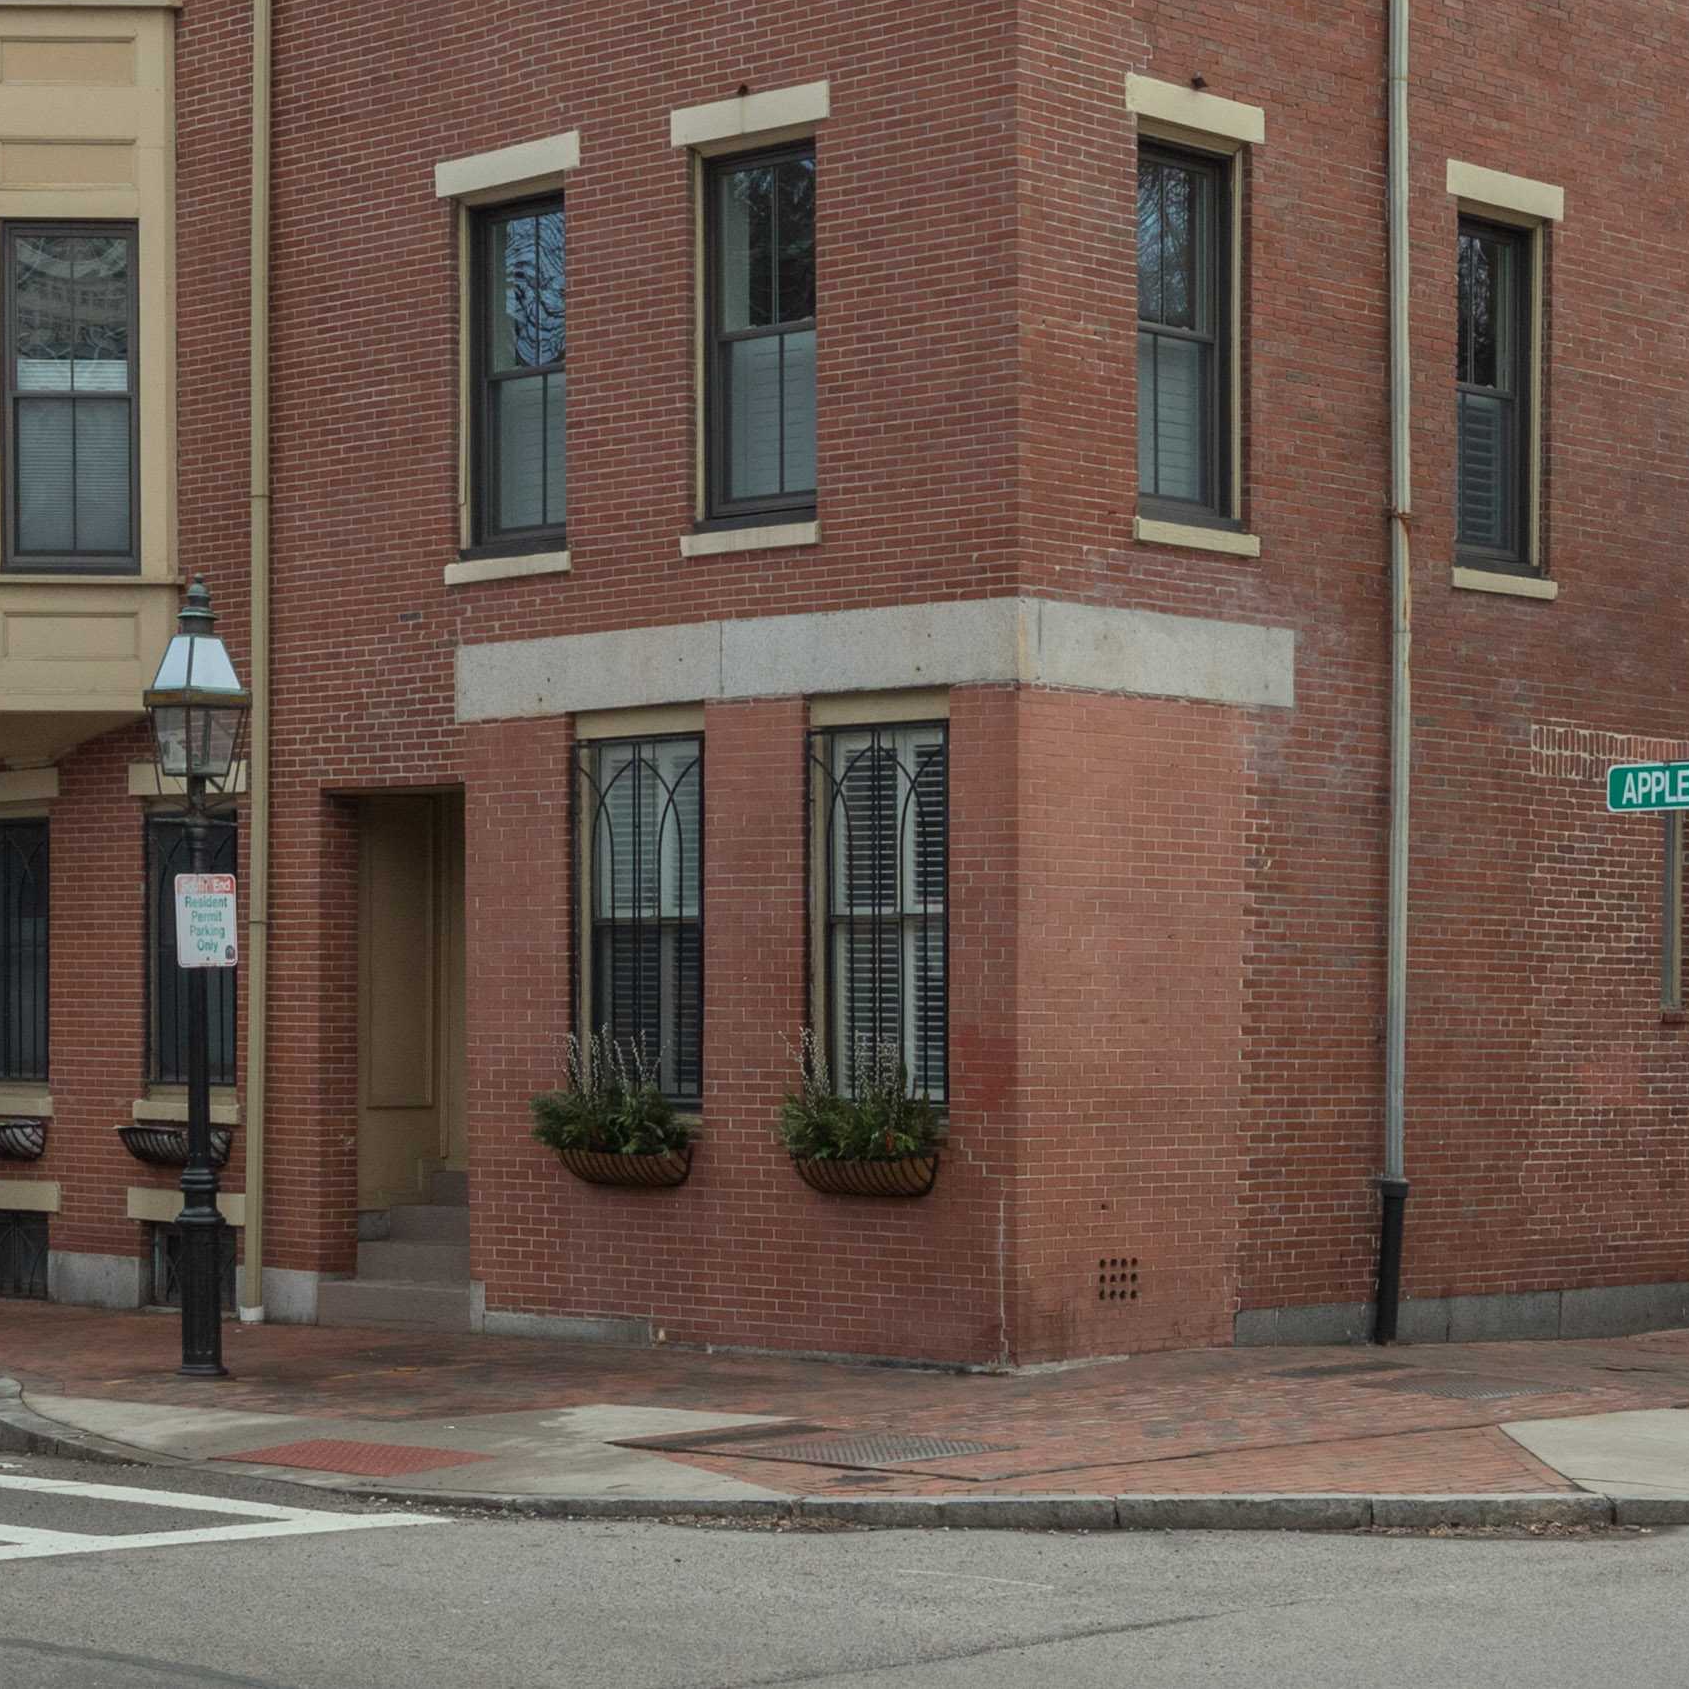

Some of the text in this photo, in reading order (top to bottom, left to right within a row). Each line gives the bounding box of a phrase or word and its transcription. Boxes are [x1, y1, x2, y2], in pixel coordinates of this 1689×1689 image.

[213, 878, 231, 891] End
[184, 895, 228, 908] Resident
[191, 910, 223, 922] Permit
[189, 924, 225, 939] Parking
[197, 938, 219, 953] Only
